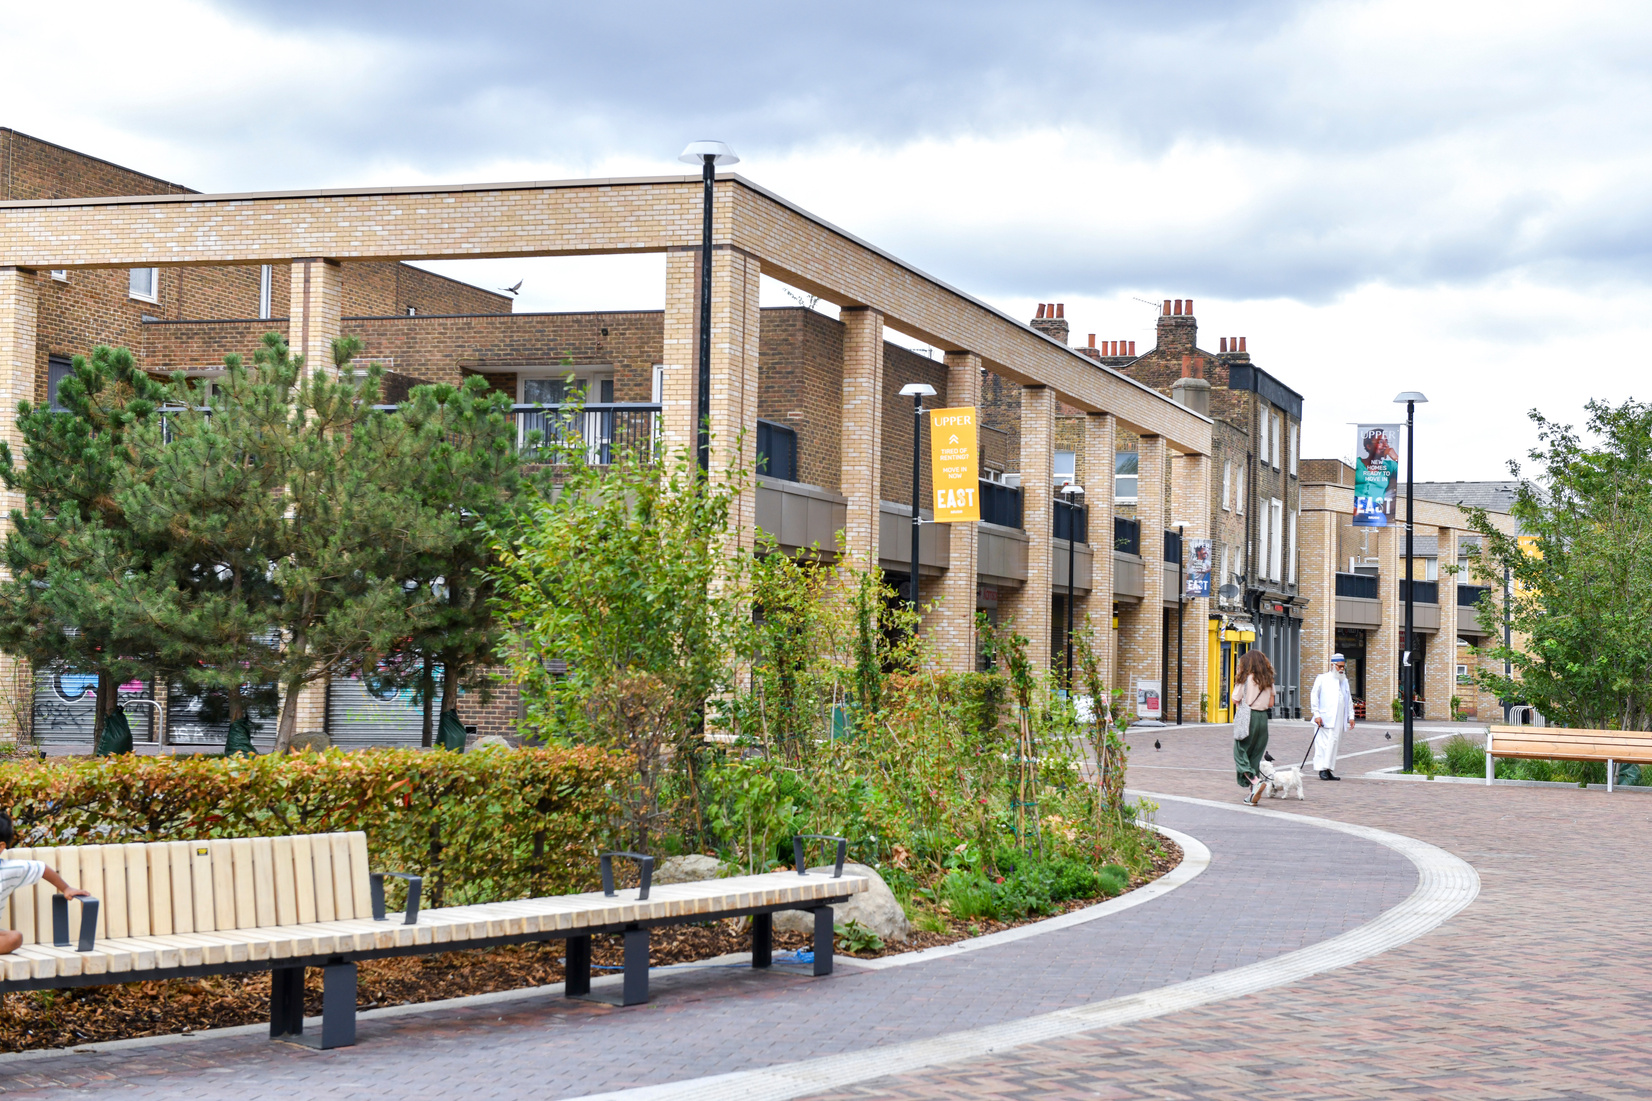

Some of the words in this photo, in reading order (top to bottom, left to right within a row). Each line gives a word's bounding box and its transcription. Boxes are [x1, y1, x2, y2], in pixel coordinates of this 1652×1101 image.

[934, 415, 972, 427] UPPER
[1360, 430, 1396, 440] UPPER
[937, 488, 975, 509] EAST
[1356, 496, 1393, 514] EAST
[1187, 579, 1209, 591] EAST
